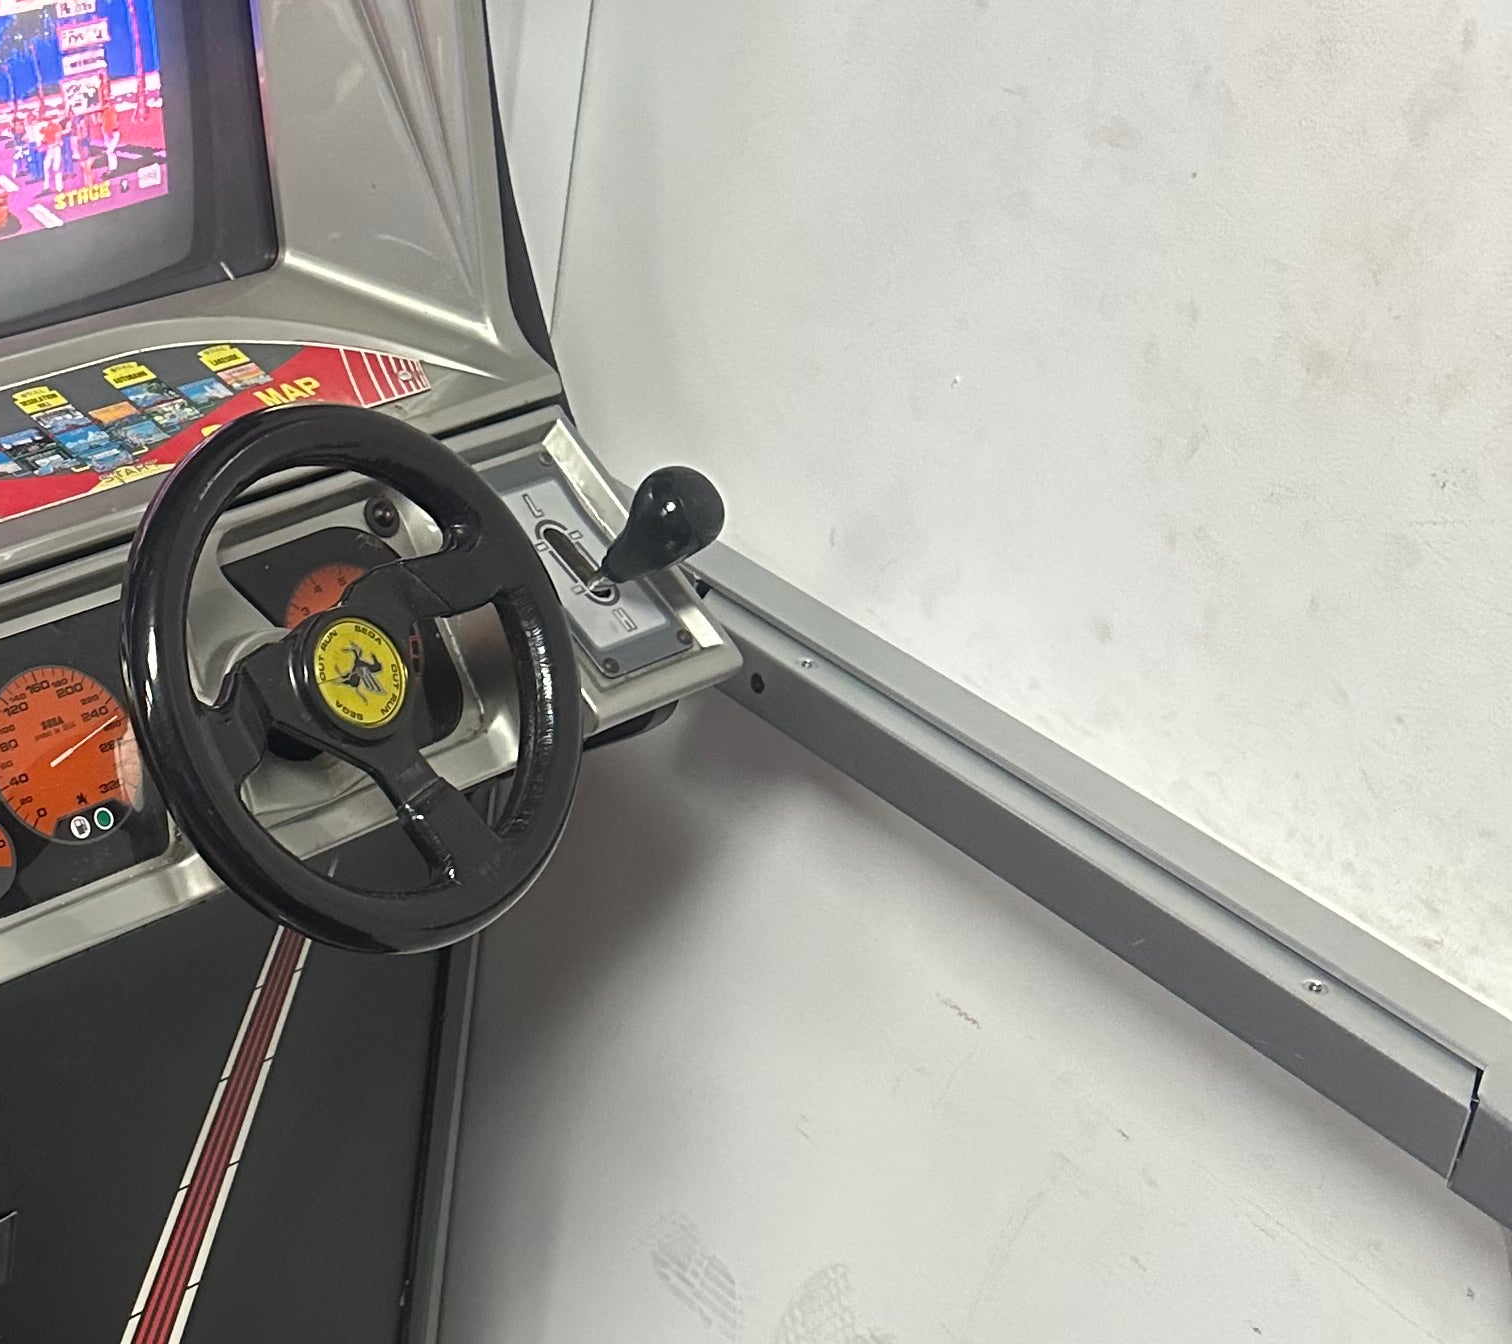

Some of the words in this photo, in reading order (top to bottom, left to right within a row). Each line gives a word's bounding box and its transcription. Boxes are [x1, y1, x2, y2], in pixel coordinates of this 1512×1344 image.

[54, 180, 112, 210] STAGE
[253, 376, 320, 407] MAP
[321, 629, 338, 652] RUN
[354, 625, 382, 646] SEGA
[317, 657, 326, 681] OUT
[390, 663, 400, 692] OUT
[25, 679, 50, 694] 160
[56, 682, 84, 699] 200
[4, 701, 29, 717] 120
[81, 705, 109, 722] 240
[380, 693, 399, 715] RUN
[0, 738, 19, 752] 80
[9, 772, 29, 786] 40
[36, 807, 48, 818] 0
